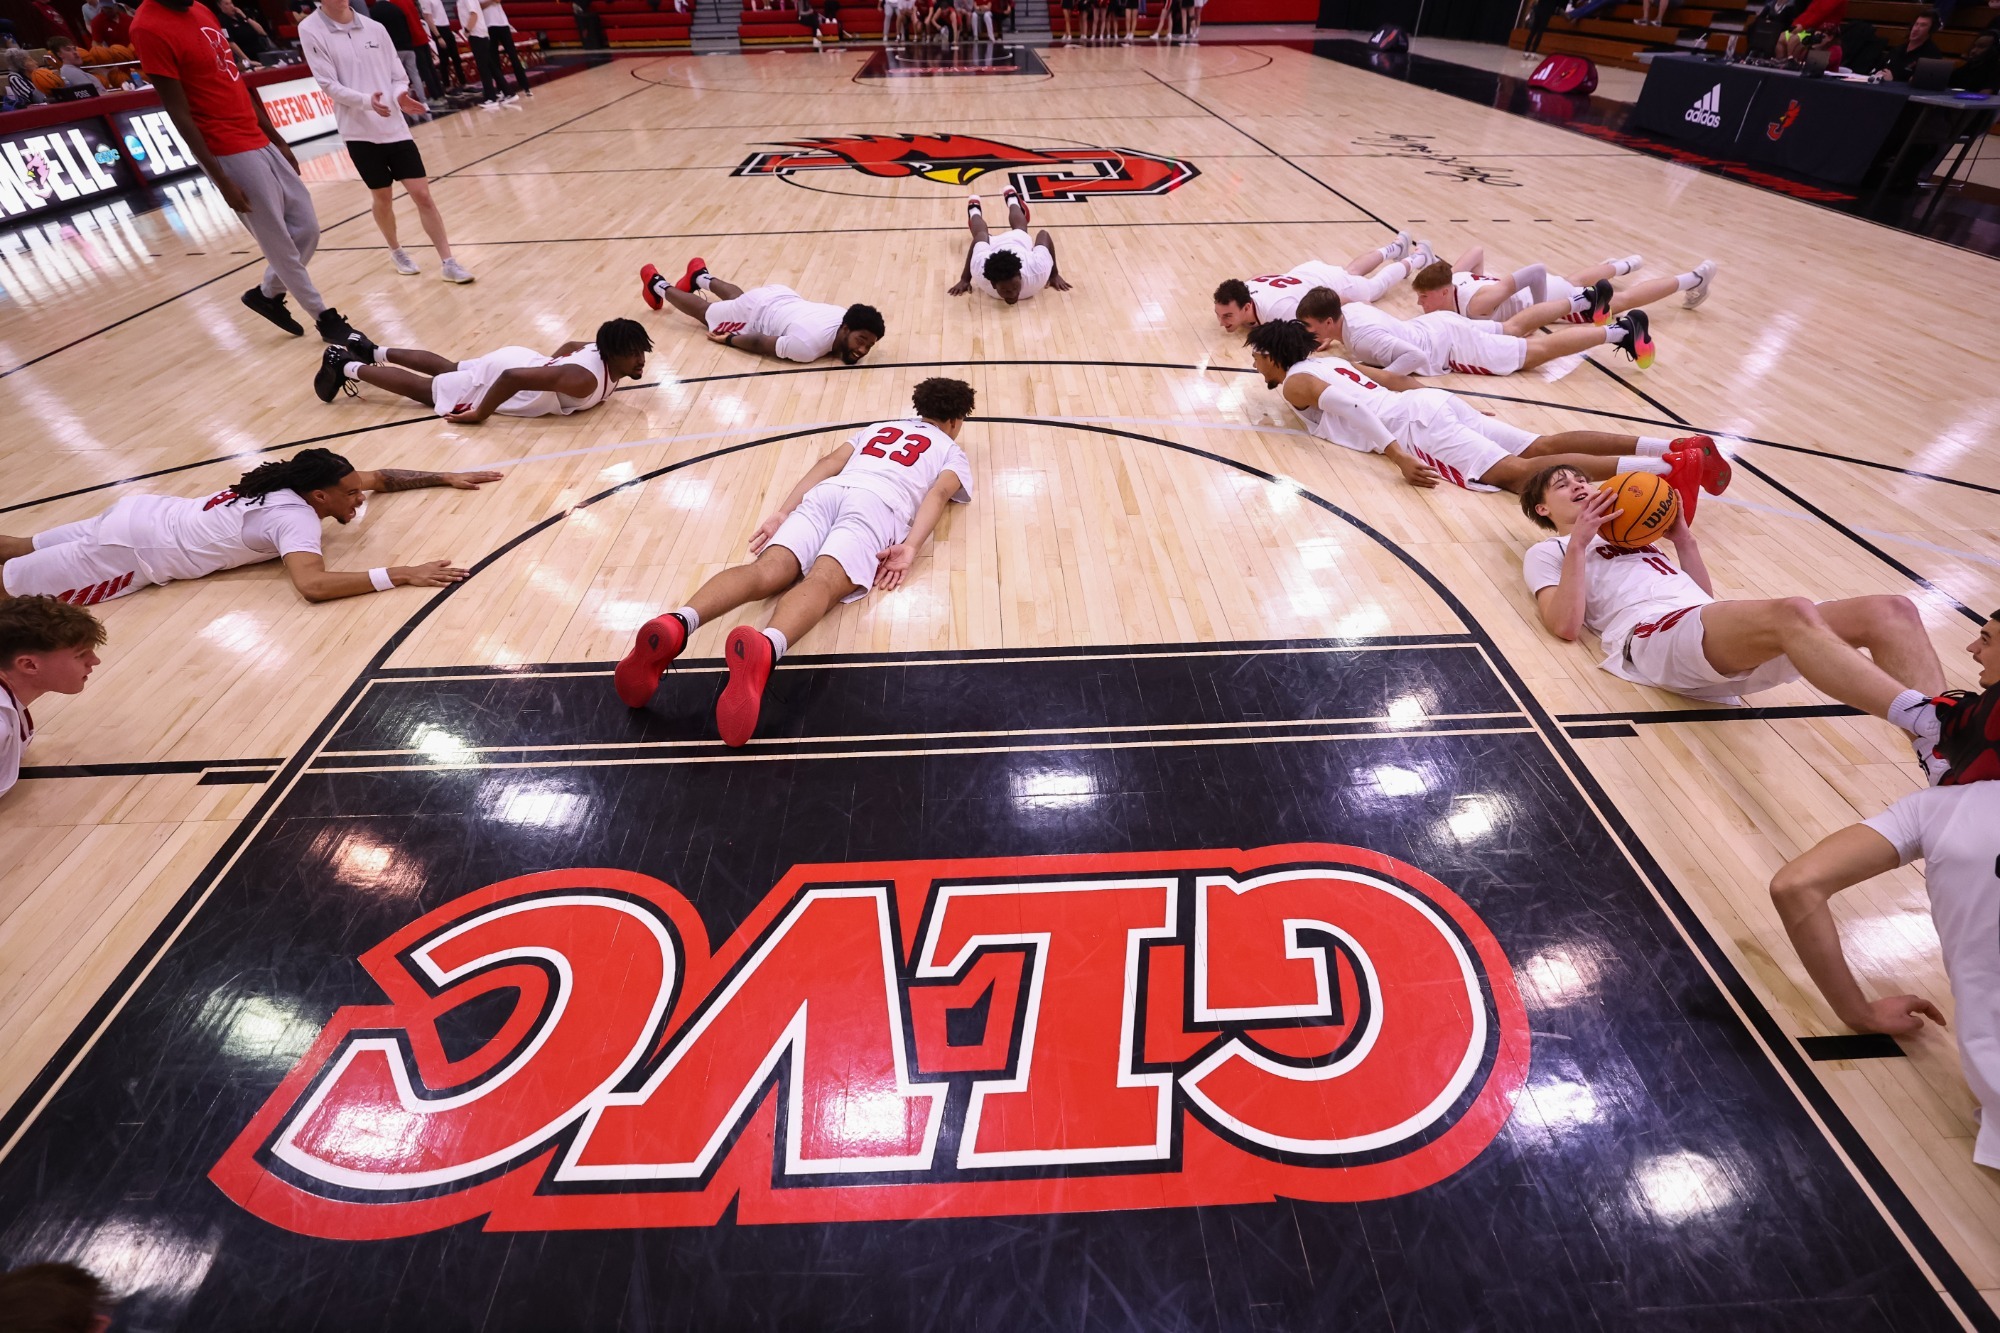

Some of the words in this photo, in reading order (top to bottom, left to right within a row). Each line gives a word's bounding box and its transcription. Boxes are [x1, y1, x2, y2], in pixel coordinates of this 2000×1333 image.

[263, 94, 316, 128] DEFEND
[1685, 108, 1721, 128] adidas
[859, 426, 932, 468] 23
[1641, 556, 1679, 576] 11
[248, 858, 1502, 1208] GLVC
